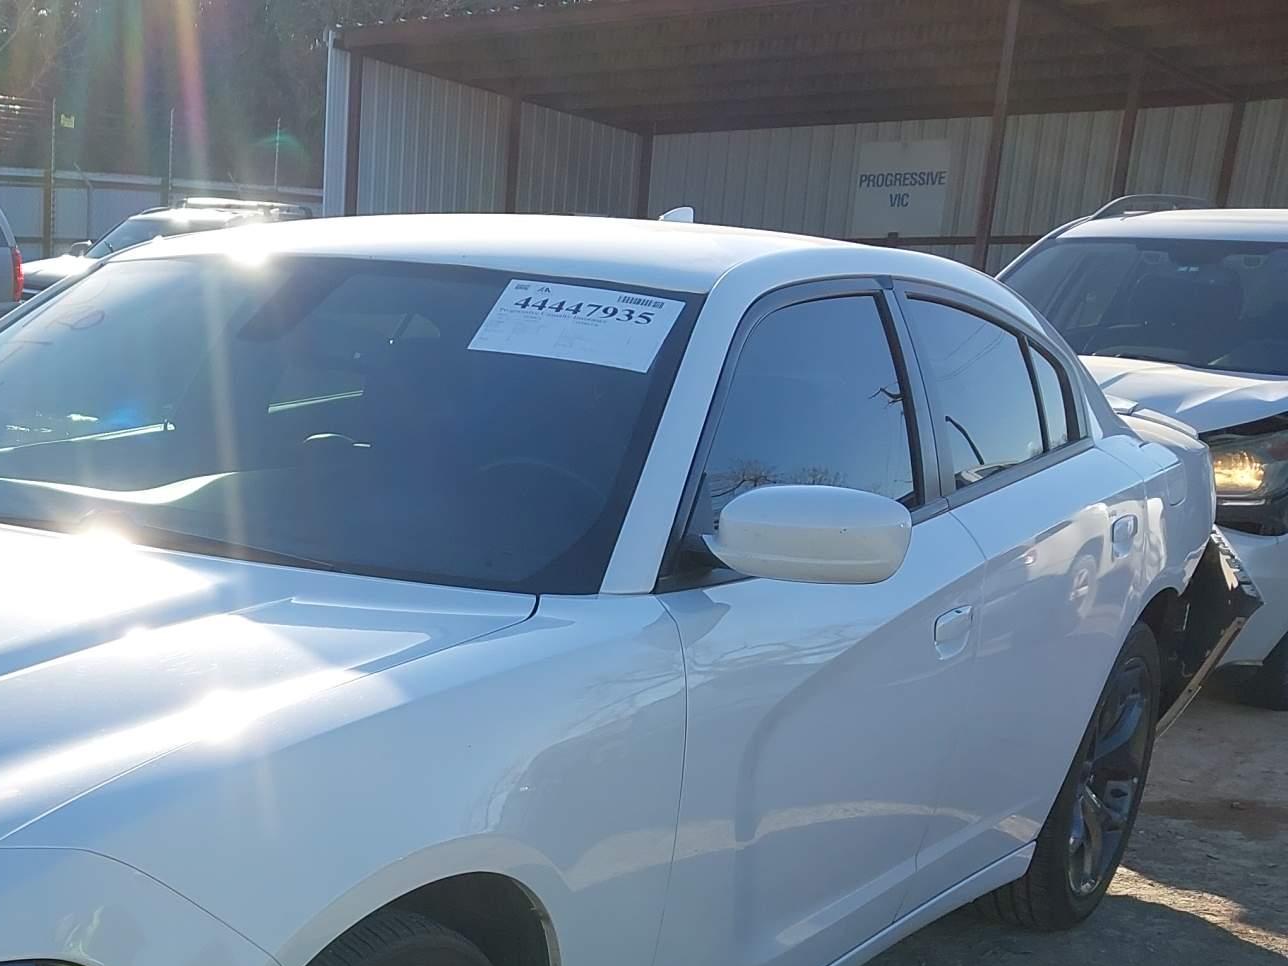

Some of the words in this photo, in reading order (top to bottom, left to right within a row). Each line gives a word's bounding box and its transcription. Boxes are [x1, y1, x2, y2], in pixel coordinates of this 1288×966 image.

[859, 170, 947, 188] PROGRESSIVE
[889, 193, 910, 208] VIC
[513, 296, 655, 326] 44447935
